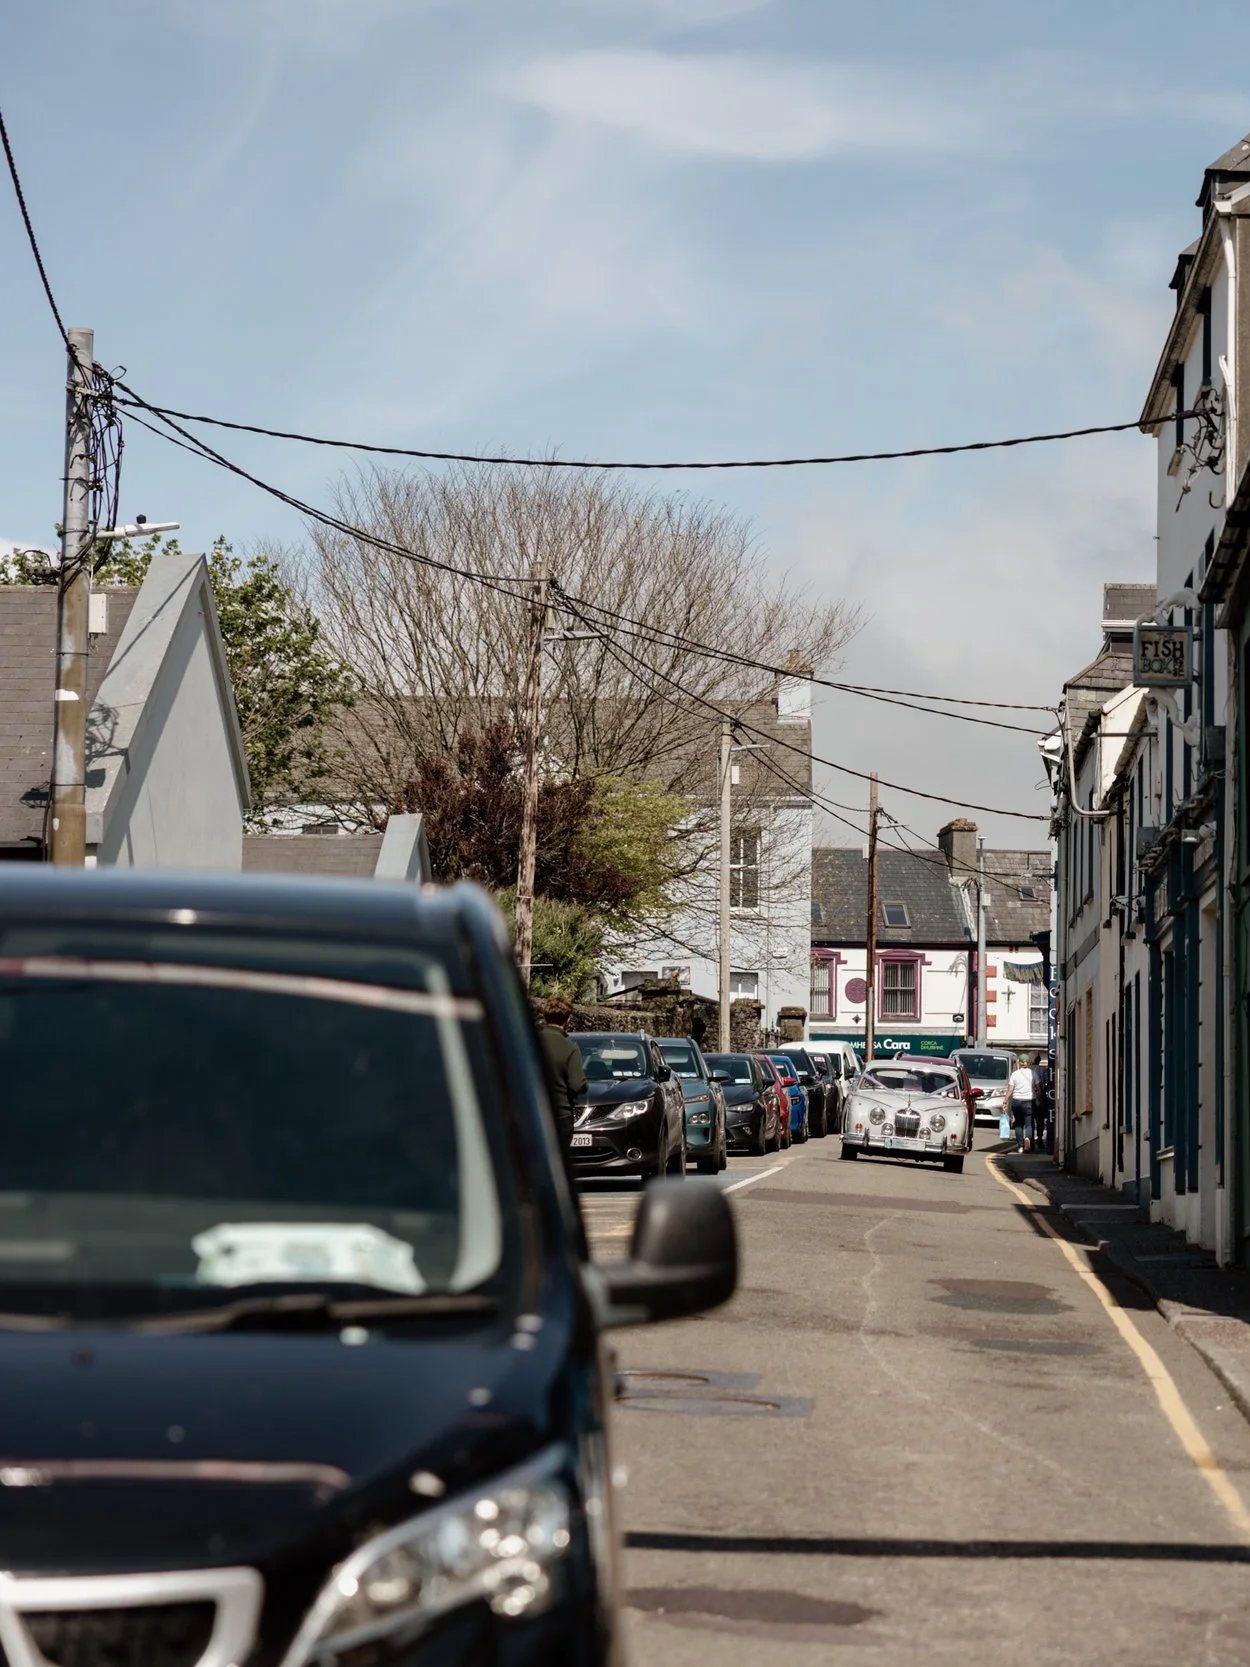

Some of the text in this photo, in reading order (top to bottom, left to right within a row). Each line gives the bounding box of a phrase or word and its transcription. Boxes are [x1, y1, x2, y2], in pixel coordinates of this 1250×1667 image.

[1141, 640, 1184, 658] FISH
[883, 1038, 911, 1050] Cara
[573, 1137, 591, 1146] 2013
